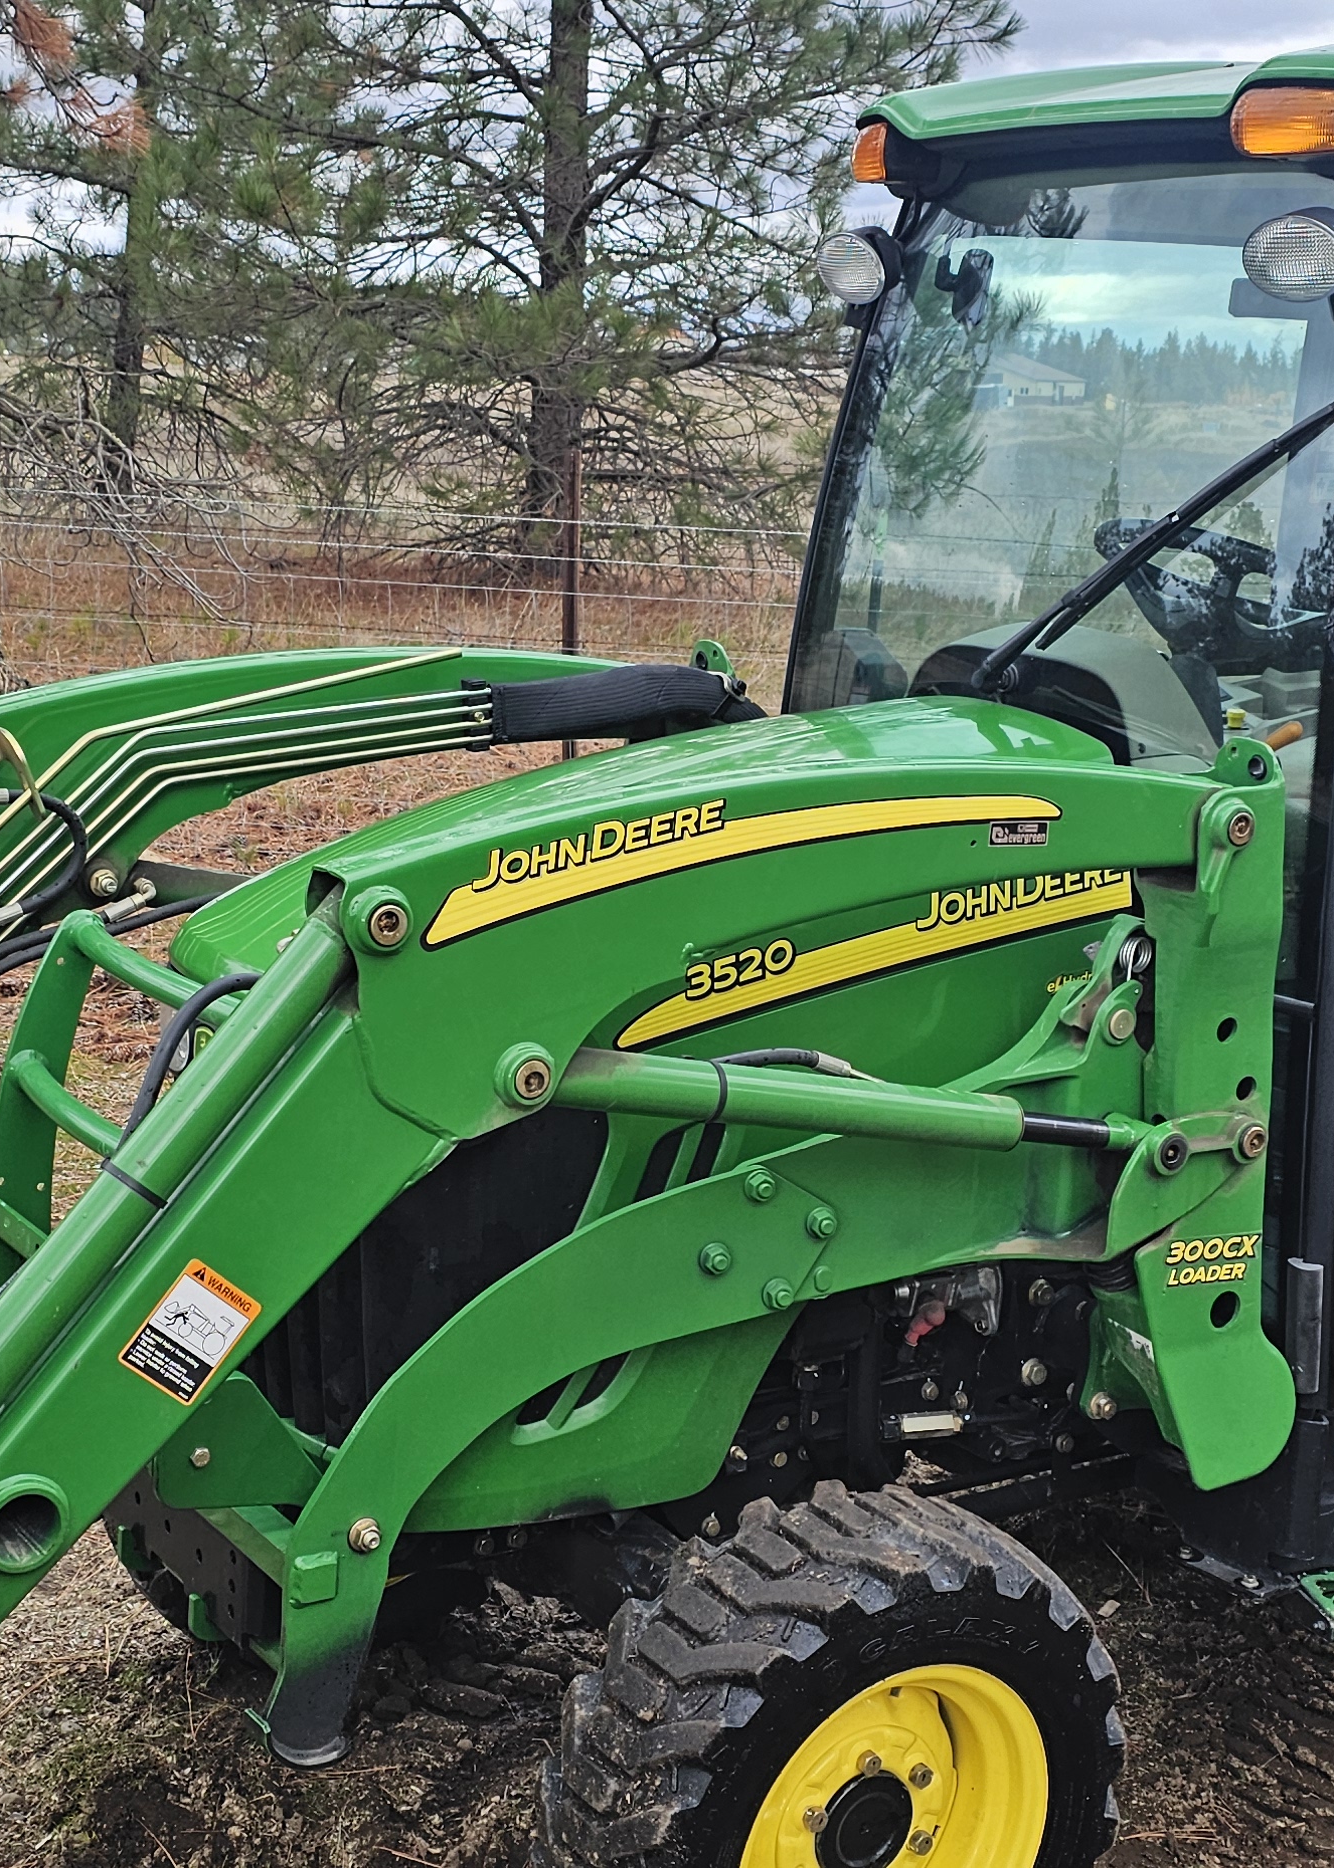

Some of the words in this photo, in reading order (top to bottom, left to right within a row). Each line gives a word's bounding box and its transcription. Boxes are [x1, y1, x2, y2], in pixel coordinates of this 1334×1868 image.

[471, 833, 587, 893] JOHN
[590, 798, 726, 861] DEERE
[915, 879, 1013, 932] JOHN
[683, 938, 796, 1000] 3520
[1165, 1234, 1261, 1266] 300CX
[207, 1275, 252, 1313] WARNING
[1166, 1262, 1247, 1287] LOADER
